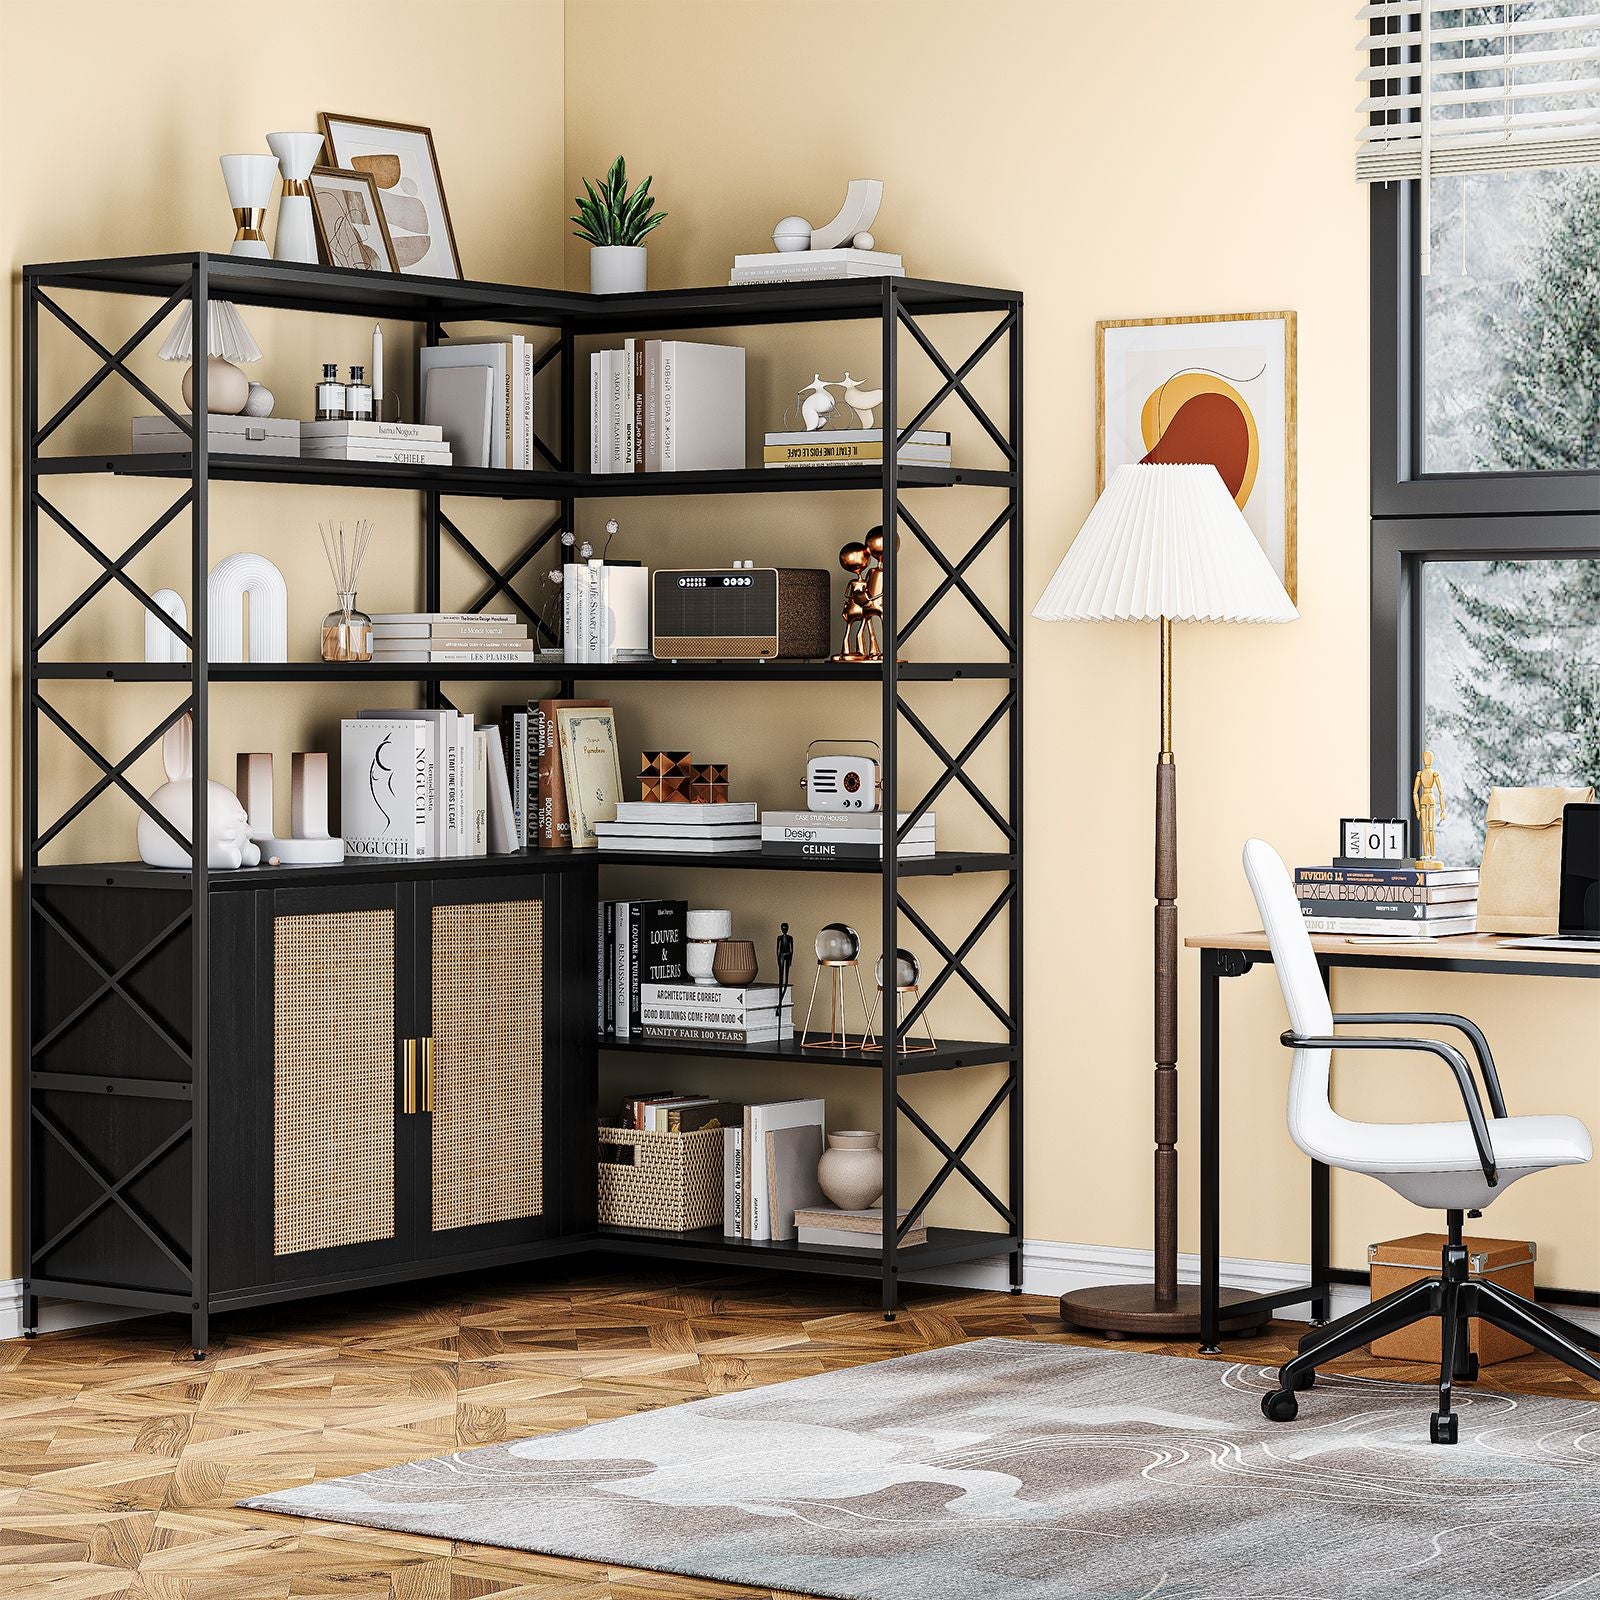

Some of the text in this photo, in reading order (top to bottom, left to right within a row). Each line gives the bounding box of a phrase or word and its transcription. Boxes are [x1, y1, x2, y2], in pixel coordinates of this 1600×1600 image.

[664, 358, 672, 392] НОВЫЙ
[378, 425, 419, 437] Isamu Noguchi
[393, 453, 426, 464] SCHIELE
[470, 653, 484, 661] LES
[486, 653, 519, 661] PLAISIRS
[538, 710, 546, 757] CHAPMAN
[546, 719, 554, 748] CALLUM
[527, 706, 539, 839] БОРИС ПАСТЕРНАК
[416, 747, 426, 825] NOGUCHI
[449, 803, 456, 811] LE
[545, 796, 553, 839] BOOK COVER
[794, 814, 849, 823] CASE STUDY HOUSES
[556, 822, 569, 831] BOO
[784, 828, 817, 841] Design
[345, 841, 409, 856] NOGUCHI
[802, 844, 836, 855] CELINE
[1350, 832, 1360, 854] JAN
[631, 924, 639, 953] LOUVRE
[650, 929, 679, 945] LOUVRE
[656, 989, 722, 1003] ARCHITECTURE CORRECT
[643, 1008, 659, 1020] GOOD
[659, 1010, 687, 1021] BUILDINGS
[687, 1012, 704, 1022] COME
[704, 1013, 720, 1024] FROM
[645, 1027, 744, 1042] VANITY FAIR 100 YEARS
